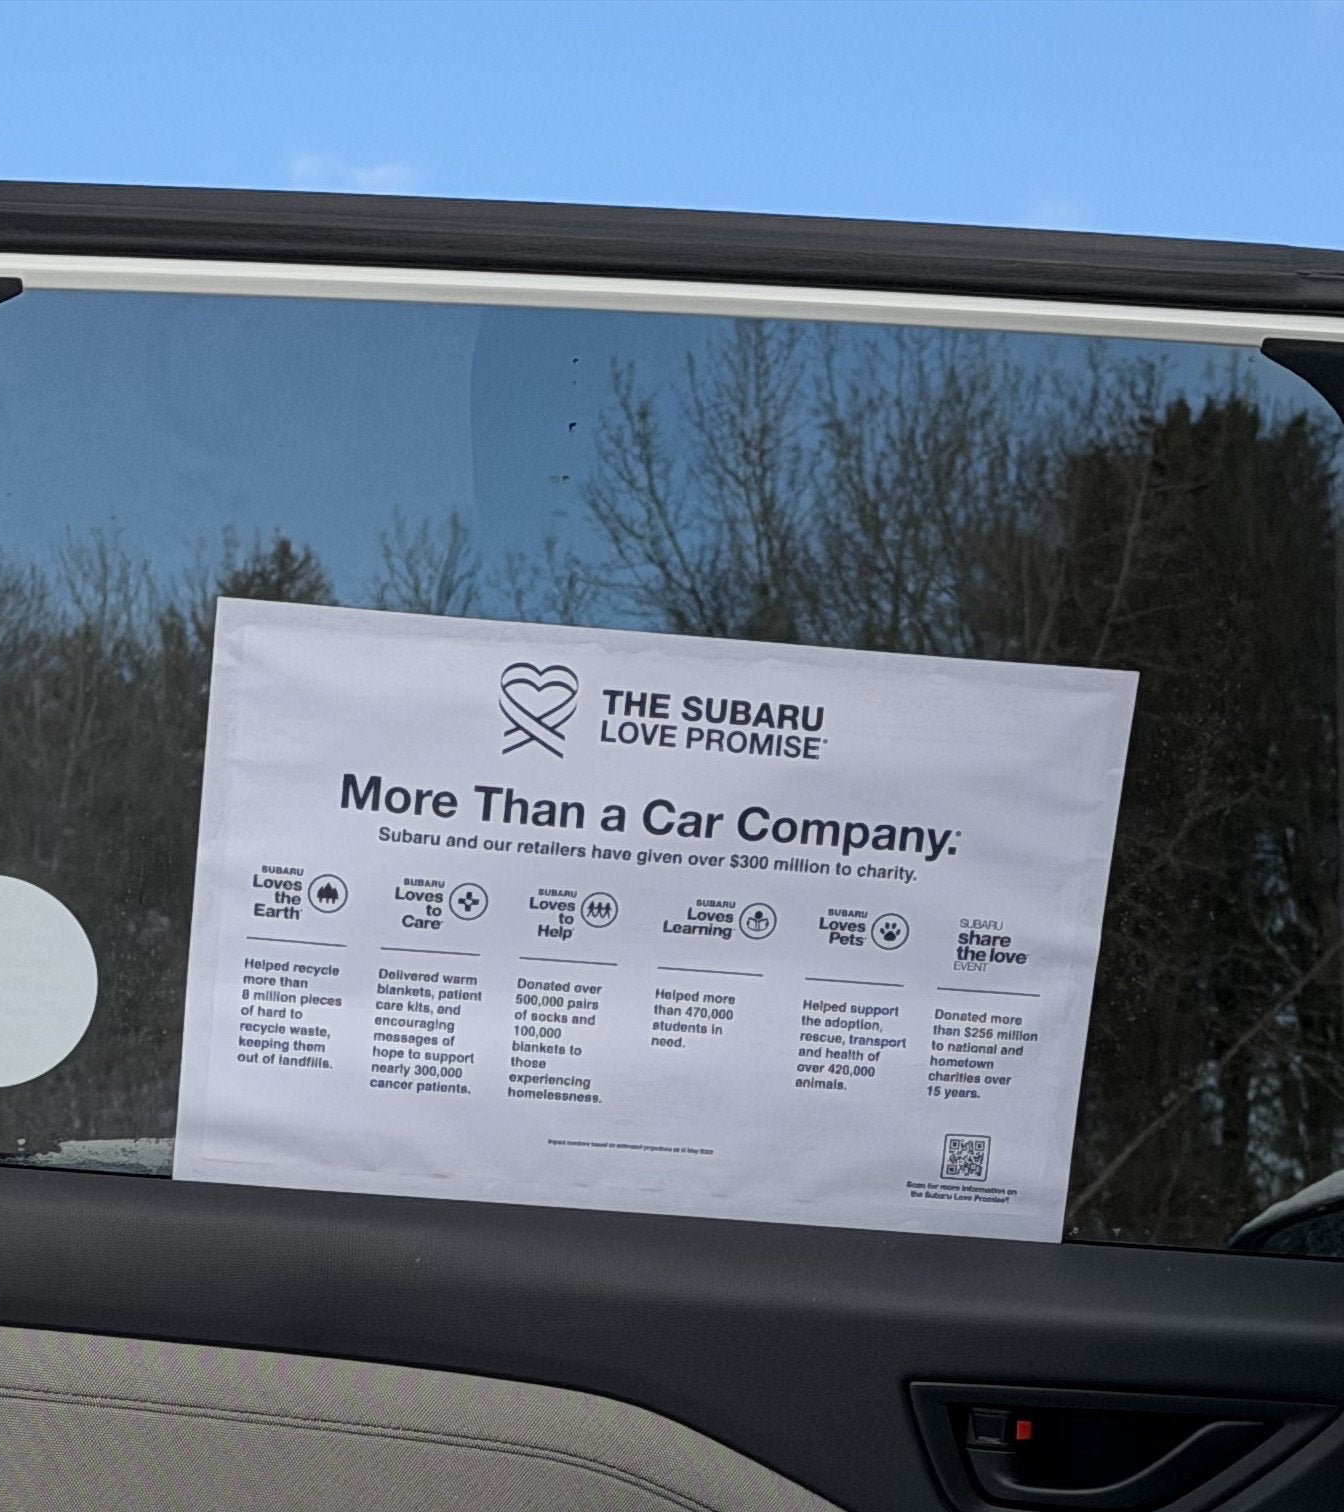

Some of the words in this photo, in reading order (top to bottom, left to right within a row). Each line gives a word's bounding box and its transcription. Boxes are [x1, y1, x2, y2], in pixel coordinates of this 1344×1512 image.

[602, 689, 671, 719] THE
[681, 695, 824, 732] SUBARU
[600, 720, 678, 748] LOVE
[340, 773, 458, 818] More
[474, 785, 585, 829] Than
[600, 804, 626, 832] a
[642, 799, 724, 839] Car
[378, 826, 441, 846] Subaru
[445, 835, 478, 849] and
[483, 839, 513, 852] our
[517, 841, 586, 858] retailers
[591, 844, 632, 861] have
[636, 848, 683, 866] given
[688, 854, 726, 867] over
[729, 853, 769, 870] $300
[773, 857, 830, 875] million
[835, 862, 852, 876] to
[857, 863, 917, 884] charity.
[261, 865, 304, 878] SUBARU
[252, 874, 303, 892] Loves
[403, 877, 445, 890] SUBARU
[274, 890, 302, 906] the
[394, 886, 444, 904] Loves
[538, 888, 578, 899] SUBARU
[426, 904, 442, 917] to
[529, 896, 576, 912] Loves
[696, 899, 736, 910] SUBARU
[558, 912, 575, 925] to
[687, 907, 734, 924] Loves
[828, 908, 868, 920] SUBARU
[819, 916, 866, 933] Loves
[959, 918, 1004, 932] SUBARU
[958, 930, 1012, 948] share
[956, 945, 987, 962] the
[244, 958, 290, 973] Helped
[293, 964, 340, 977] recycle
[953, 960, 988, 972] EVENT
[243, 975, 276, 986] more
[279, 976, 308, 989] than
[378, 968, 440, 983] Delivered
[442, 975, 478, 986] warm
[376, 983, 435, 1000] blankets,
[438, 989, 482, 1001] patient
[517, 978, 571, 993] Donated
[573, 984, 603, 995] over
[241, 988, 250, 1000] 8
[253, 990, 297, 1003] million
[300, 993, 342, 1007] pieces
[515, 993, 564, 1008] 500,000
[567, 998, 599, 1011] pairs
[655, 988, 700, 1003] Helped
[702, 994, 736, 1005] more
[240, 1004, 255, 1016] of
[257, 1005, 287, 1019] hard
[290, 1008, 303, 1020] to
[375, 1000, 404, 1012] care
[407, 1000, 434, 1015] kits,
[436, 1004, 461, 1016] and
[654, 1004, 682, 1016] than
[685, 1006, 734, 1021] 470,000
[802, 999, 847, 1014] Helped
[850, 1004, 899, 1018] support
[374, 1016, 455, 1034] encouraging
[514, 1009, 528, 1021] of
[531, 1011, 568, 1024] socks
[571, 1014, 596, 1026] and
[801, 1015, 822, 1027] the
[824, 1017, 883, 1033] adoption,
[934, 1008, 987, 1023] Donated
[990, 1015, 1023, 1026] more
[239, 1022, 286, 1036] recycle
[289, 1026, 331, 1039] waste,
[514, 1025, 562, 1039] 100,000
[652, 1020, 708, 1034] students
[711, 1023, 723, 1035] in
[933, 1024, 961, 1037] than
[964, 1026, 994, 1039] $256
[996, 1030, 1038, 1042] million
[238, 1035, 290, 1053] keeping
[293, 1040, 326, 1053] them
[373, 1032, 438, 1047] messages
[442, 1035, 455, 1047] of
[512, 1040, 566, 1055] blankets
[569, 1045, 582, 1056] to
[651, 1037, 686, 1048] need.
[799, 1032, 846, 1046] rescue,
[849, 1034, 906, 1050] transport
[931, 1040, 945, 1051] to
[947, 1042, 998, 1055] national
[1000, 1045, 1024, 1056] and
[237, 1052, 259, 1063] out
[262, 1053, 276, 1064] of
[278, 1054, 332, 1069] landfills.
[372, 1045, 405, 1061] hope
[408, 1048, 421, 1060] to
[424, 1052, 474, 1065] support
[510, 1056, 547, 1069] those
[798, 1047, 822, 1058] and
[825, 1047, 864, 1061] health
[867, 1051, 881, 1062] of
[929, 1055, 994, 1069] hometown
[371, 1063, 411, 1077] nearly
[414, 1064, 463, 1079] 300,000
[796, 1063, 825, 1073] over
[827, 1063, 876, 1077] 420,000
[928, 1070, 981, 1084] charities
[984, 1075, 1012, 1085] over
[369, 1079, 413, 1090] cancer
[416, 1081, 471, 1094] patients.
[508, 1073, 591, 1090] experiencing
[795, 1076, 847, 1090] animals.
[507, 1086, 602, 1103] homelessness.
[927, 1085, 941, 1097] 15
[944, 1088, 981, 1100] years.
